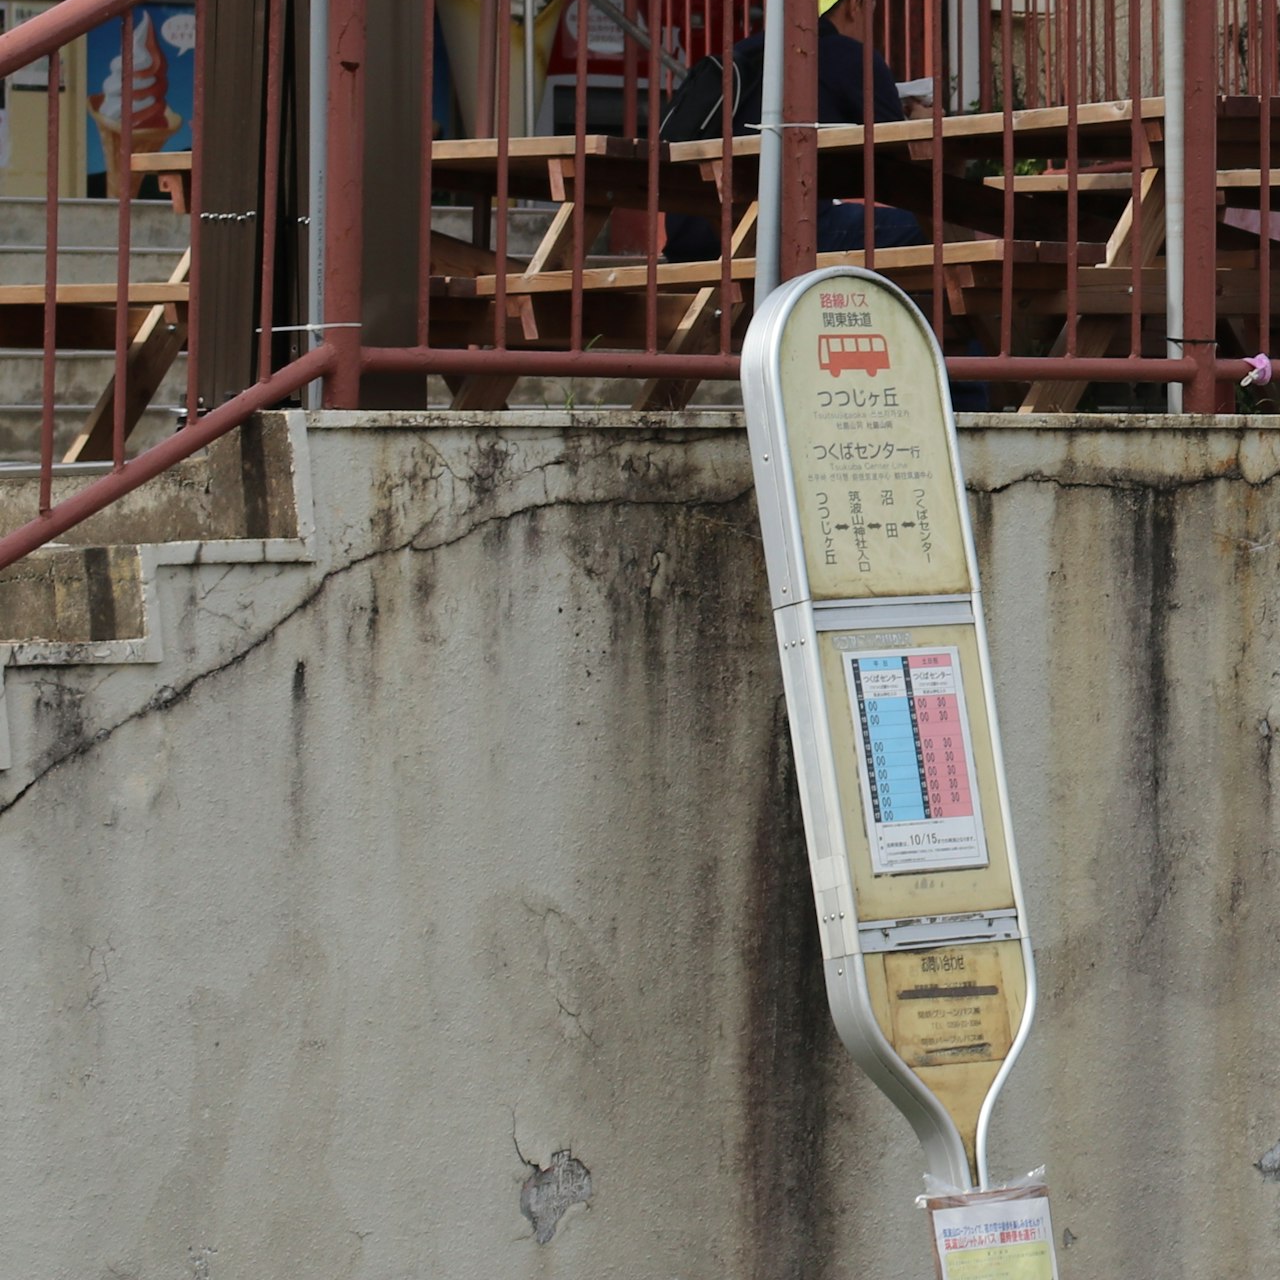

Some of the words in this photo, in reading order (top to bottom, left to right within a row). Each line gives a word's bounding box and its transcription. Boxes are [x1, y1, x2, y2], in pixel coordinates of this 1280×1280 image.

[820, 293, 868, 308] 路線バス
[822, 312, 872, 328] 関東鉄道
[813, 441, 921, 461] つくばセンター行
[848, 490, 871, 573] 筑波山神社入口
[912, 488, 933, 564] つくばセンター
[863, 674, 902, 684] つくばセンター
[913, 671, 952, 680] つくばセンター
[868, 701, 878, 712] 00
[918, 697, 927, 708] 00
[871, 714, 880, 726] 00
[920, 711, 929, 722] 00
[874, 741, 884, 752] 00
[924, 738, 933, 749] 00
[876, 755, 885, 766] 00
[926, 752, 935, 763] 00
[878, 769, 888, 780] 00
[928, 765, 937, 776] 00
[880, 783, 890, 794] 00
[930, 779, 939, 790] 00
[882, 796, 891, 807] 00
[932, 793, 941, 804] 00
[884, 810, 894, 821] 00
[934, 806, 943, 817] 00
[910, 833, 938, 846] 10/15
